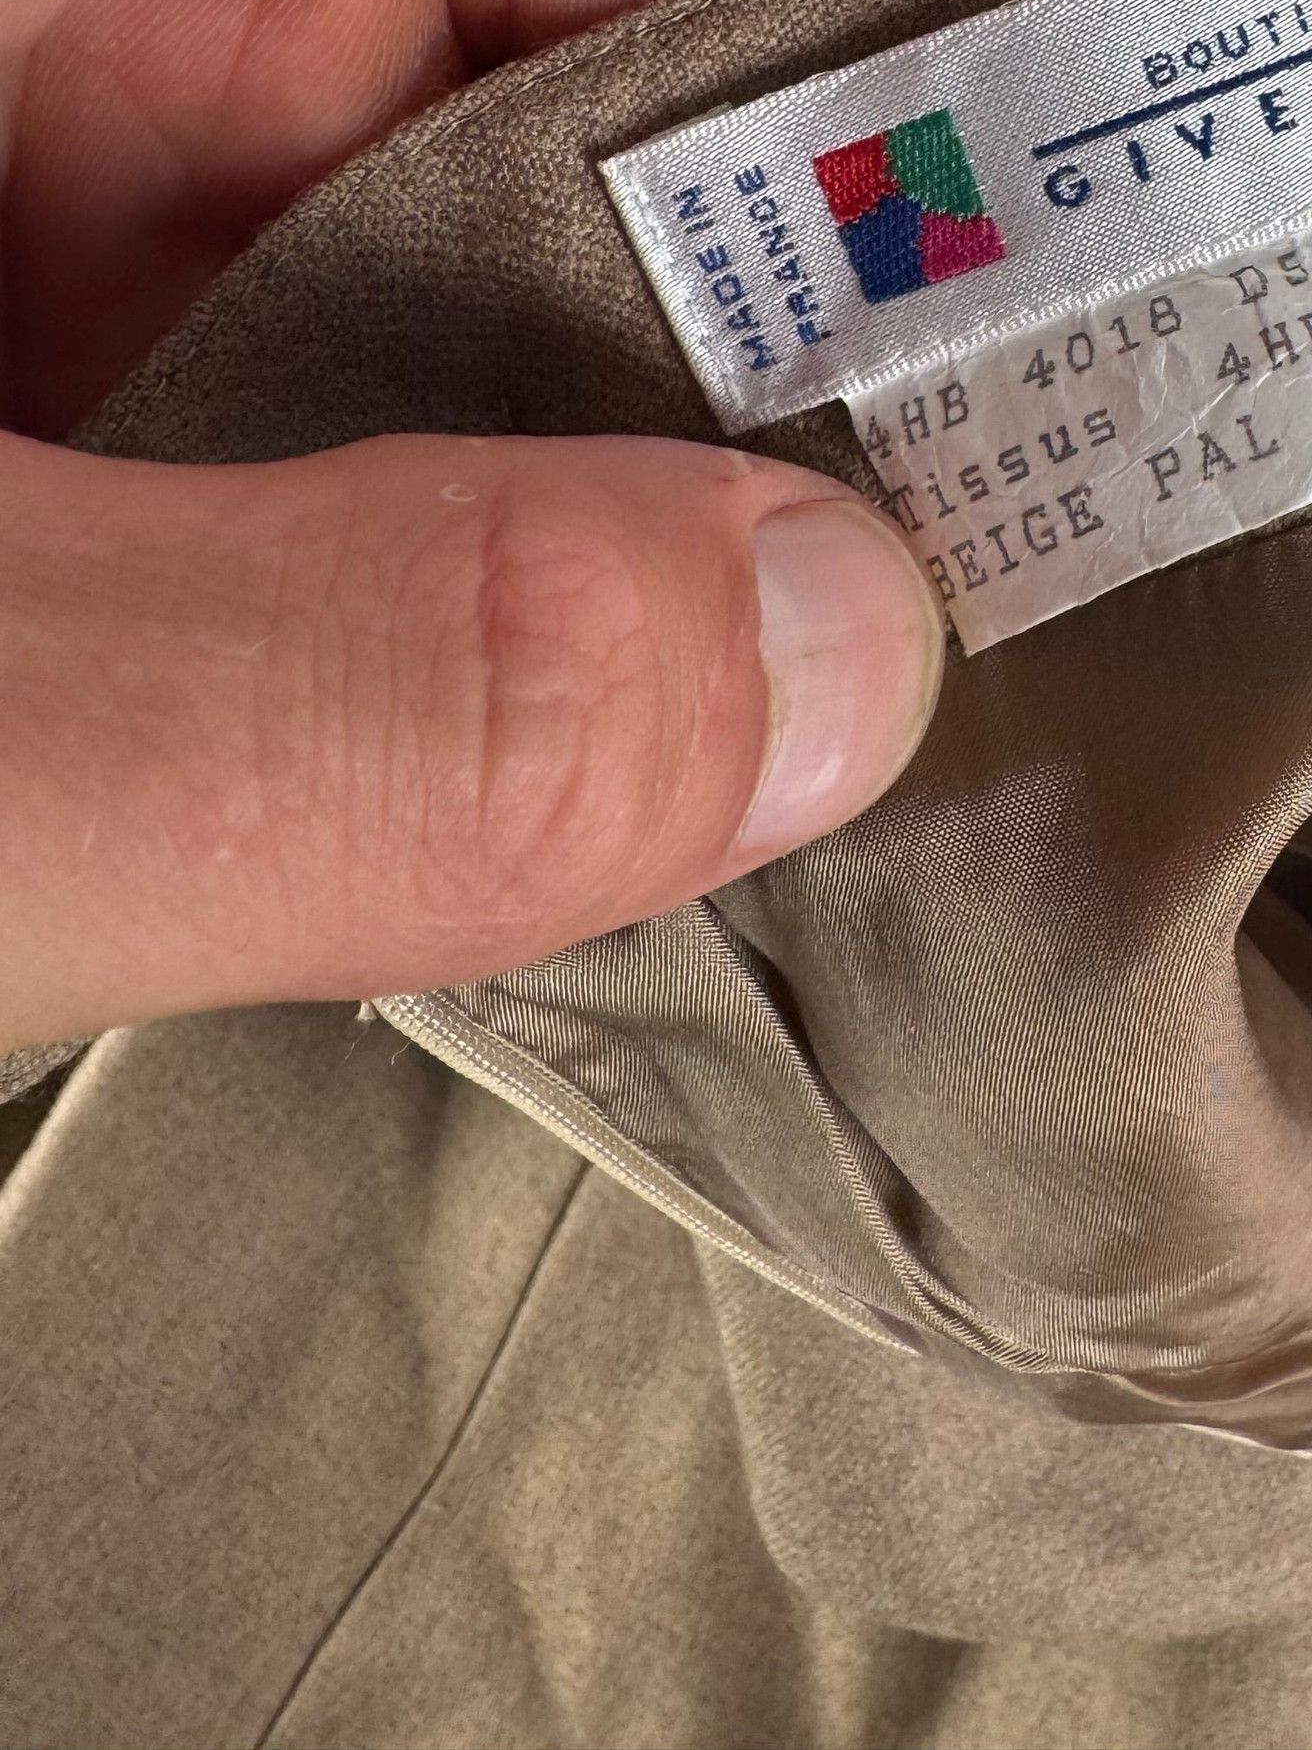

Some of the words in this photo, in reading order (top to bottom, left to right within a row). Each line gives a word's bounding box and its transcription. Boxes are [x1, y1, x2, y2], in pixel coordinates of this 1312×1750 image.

[677, 182, 714, 236] IN
[734, 164, 834, 345] FRANCE
[699, 244, 779, 371] MADE
[865, 380, 969, 459] 4HB
[1022, 294, 1182, 389] 4018
[888, 408, 1117, 532] Tissus
[926, 483, 1104, 600] BEIGE
[1145, 415, 1281, 501] PAL
